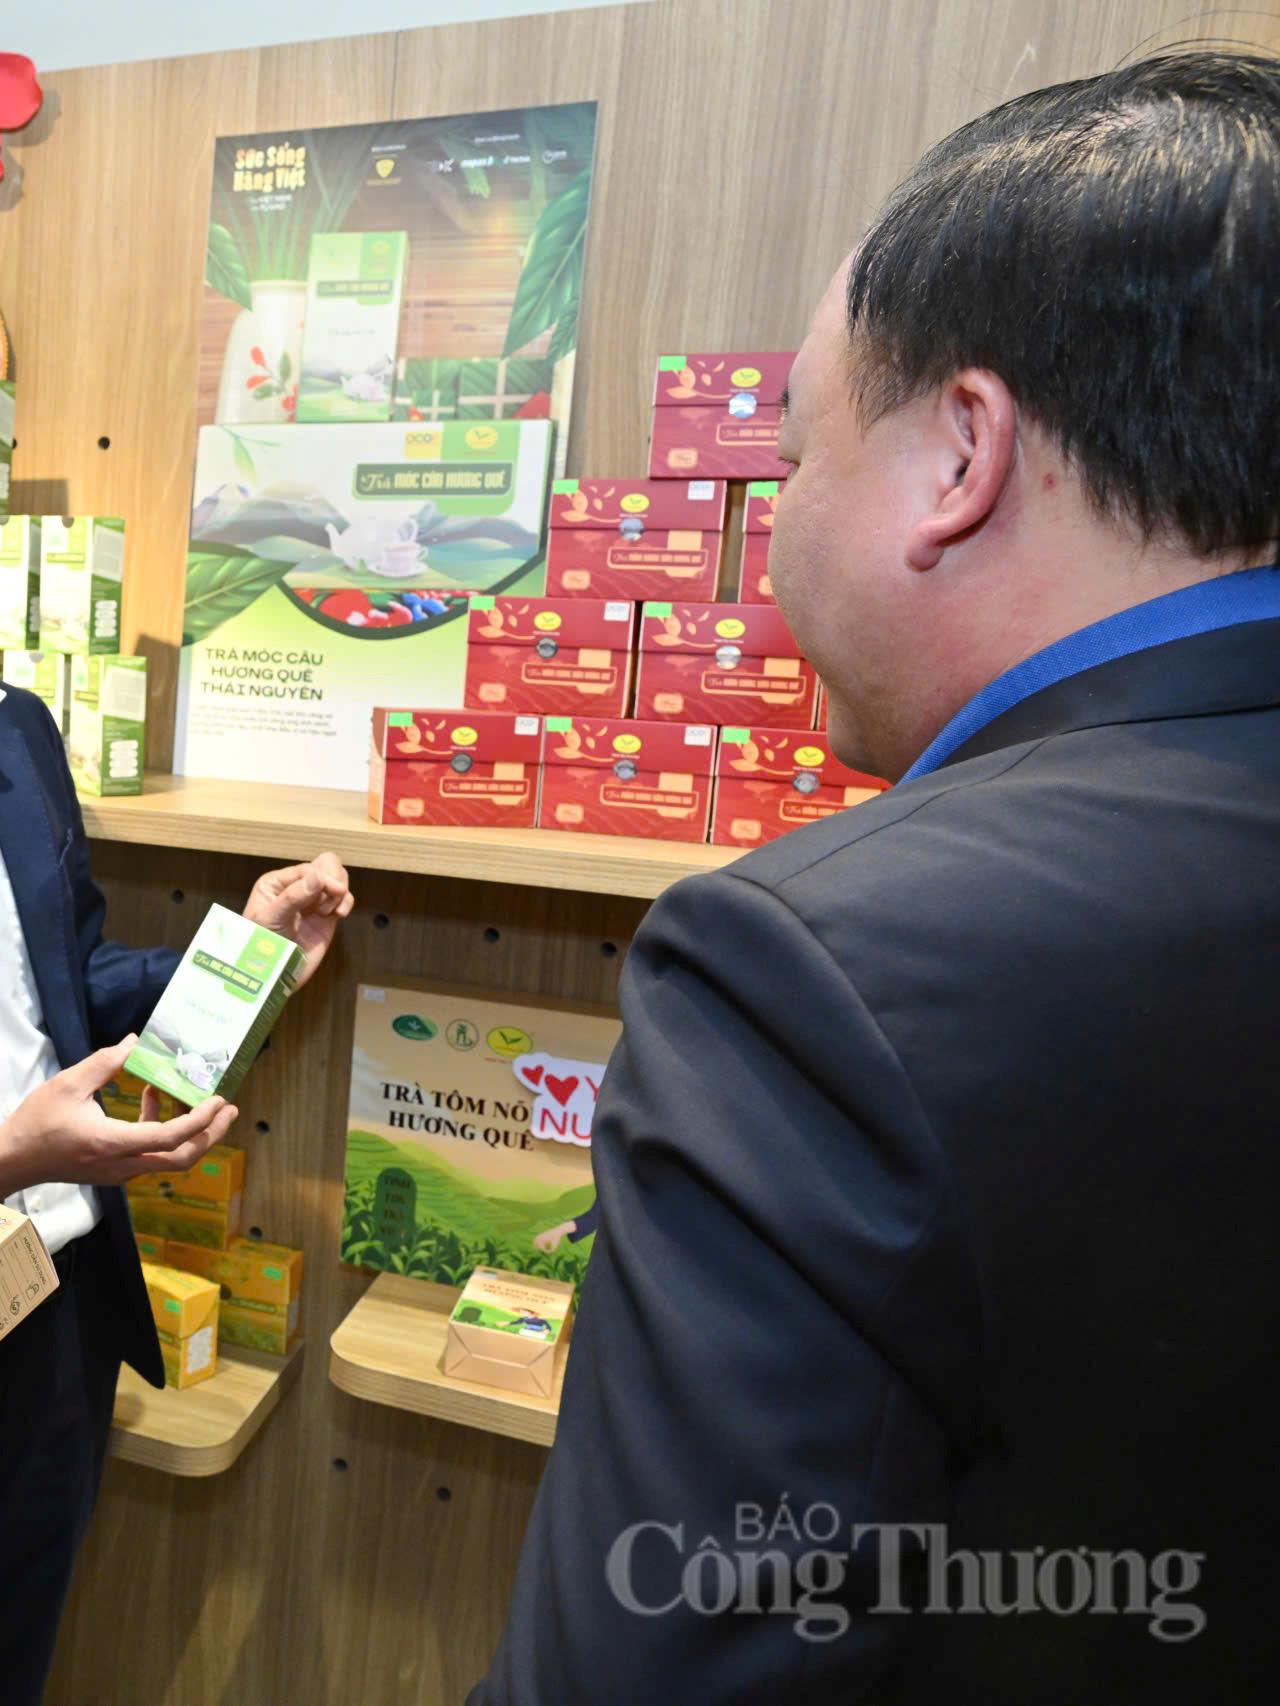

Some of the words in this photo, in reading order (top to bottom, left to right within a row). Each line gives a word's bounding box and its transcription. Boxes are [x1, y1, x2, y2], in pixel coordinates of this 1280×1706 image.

[206, 647, 238, 661] TRÀ
[286, 650, 324, 666] CÂU
[211, 666, 274, 680] HƯƠNG
[201, 681, 246, 696] THÁI
[249, 685, 323, 701] NGUYÊN
[380, 1081, 424, 1105] TRÀ
[430, 1089, 485, 1116] TÔM
[493, 1101, 529, 1123] NÕ
[389, 1110, 476, 1141] HƯƠNG
[483, 1127, 535, 1152] QUÊ
